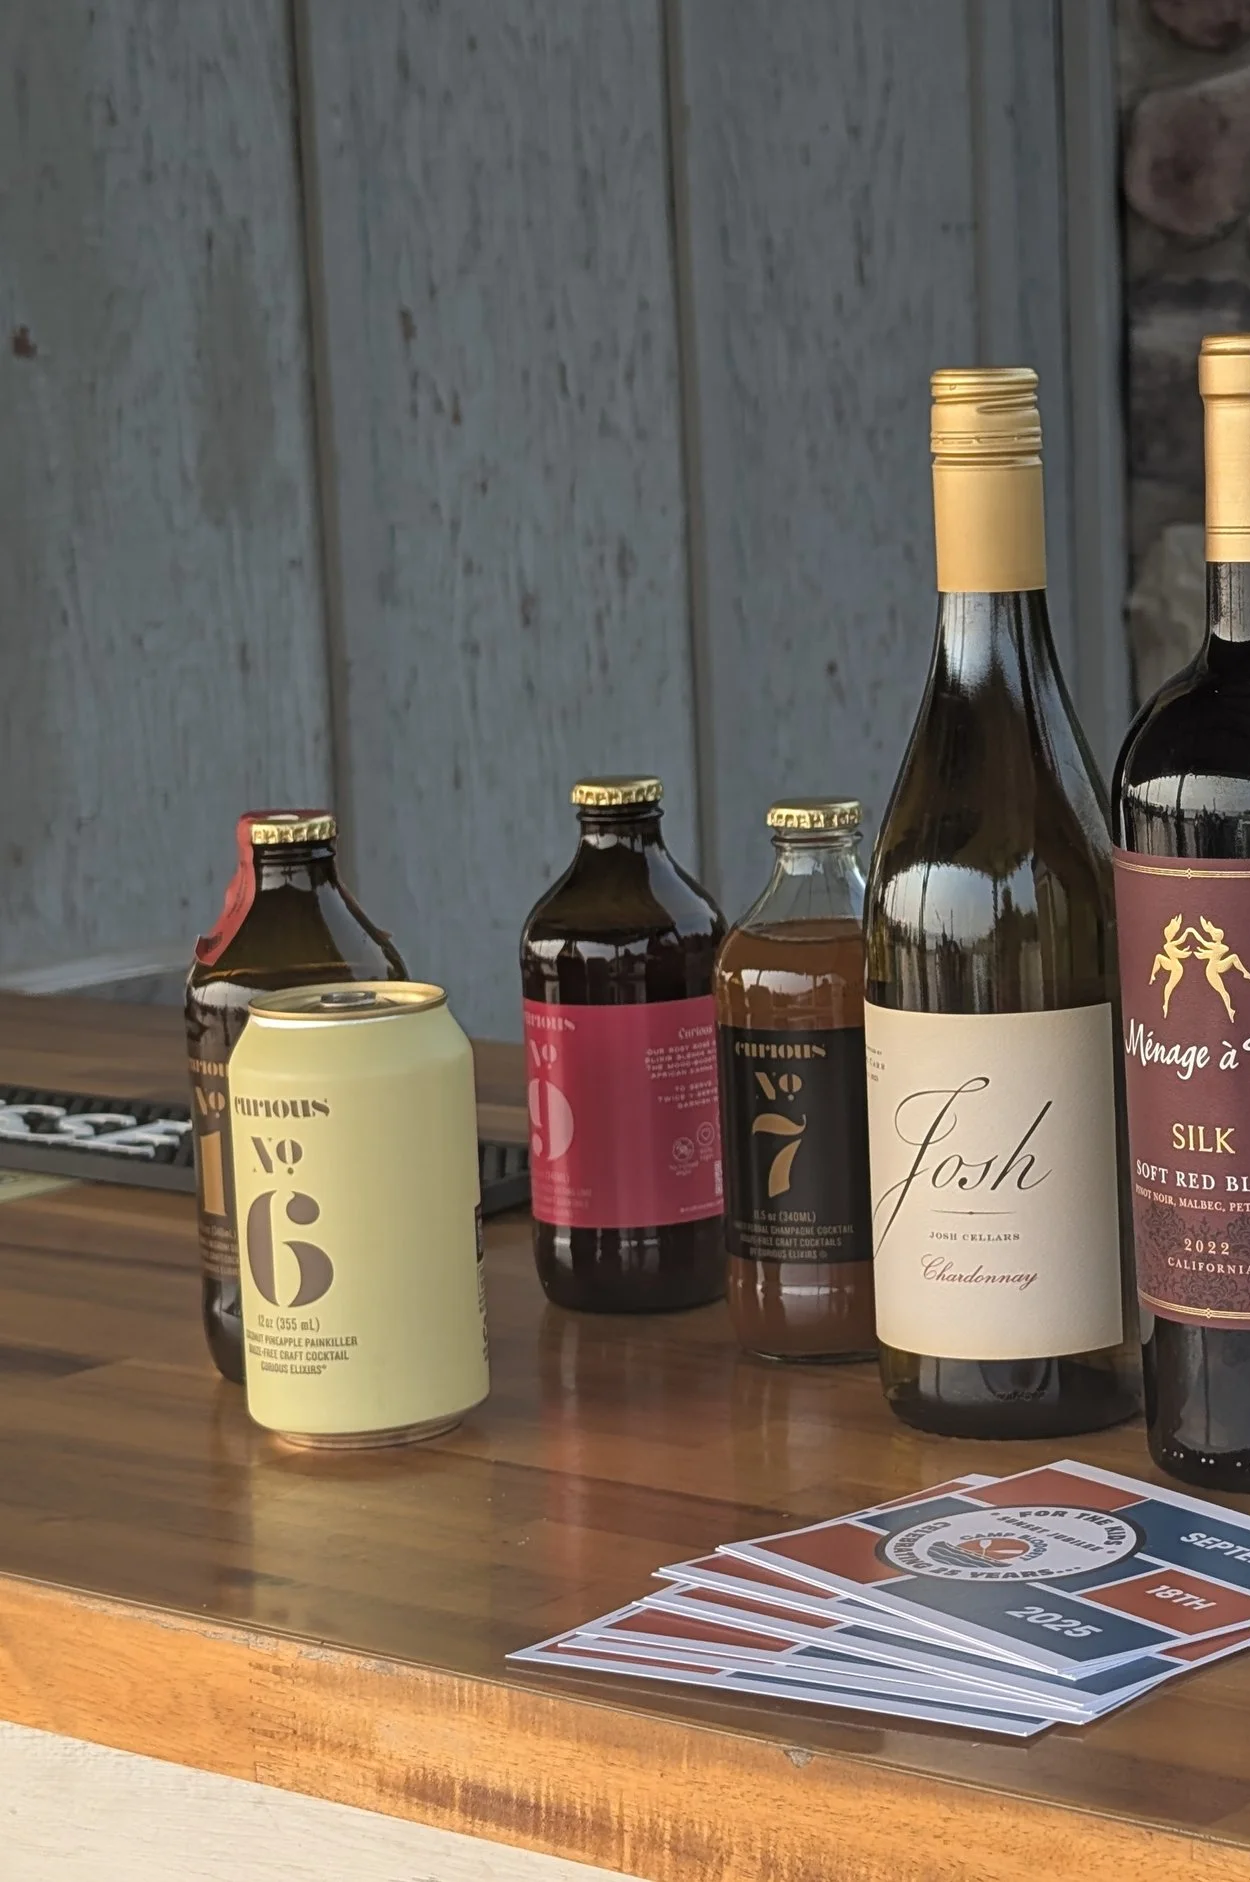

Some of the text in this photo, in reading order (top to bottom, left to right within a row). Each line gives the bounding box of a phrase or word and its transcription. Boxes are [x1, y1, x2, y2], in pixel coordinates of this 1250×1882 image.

[735, 1041, 827, 1059] curious
[1125, 1018, 1210, 1080] Ménage
[1219, 1041, 1239, 1070] à
[234, 1095, 330, 1119] curious
[528, 1077, 574, 1161] 9
[1172, 1123, 1236, 1154] SILK
[752, 1113, 807, 1198] 7
[873, 1076, 1053, 1260] Josh
[200, 1131, 227, 1216] 1
[1136, 1159, 1168, 1185] SOFT
[1175, 1171, 1216, 1191] RED
[1153, 1192, 1176, 1207] NOIR,
[1179, 1198, 1226, 1212] MALBEC,
[247, 1189, 335, 1308] 6
[929, 1232, 1021, 1242] JOSH CELLARS
[1184, 1238, 1230, 1256] 2022
[921, 1254, 1038, 1290] Chardonnay
[276, 1317, 297, 1331] (355
[301, 1318, 320, 1332] mL)
[265, 1334, 303, 1348] PINEAPPLE
[305, 1336, 358, 1347] PAINKILLER
[280, 1351, 303, 1361] CRAFT
[306, 1350, 349, 1361] COCKTAIL
[960, 1531, 1016, 1541] CAMP
[999, 1515, 1105, 1553] SUNSET JUBILEE
[1019, 1510, 1129, 1547] FOR THE KIDS
[893, 1521, 952, 1569] CELEBRATING
[930, 1566, 962, 1577] 25
[1145, 1584, 1217, 1610] 18TH
[1005, 1605, 1103, 1638] 2025
